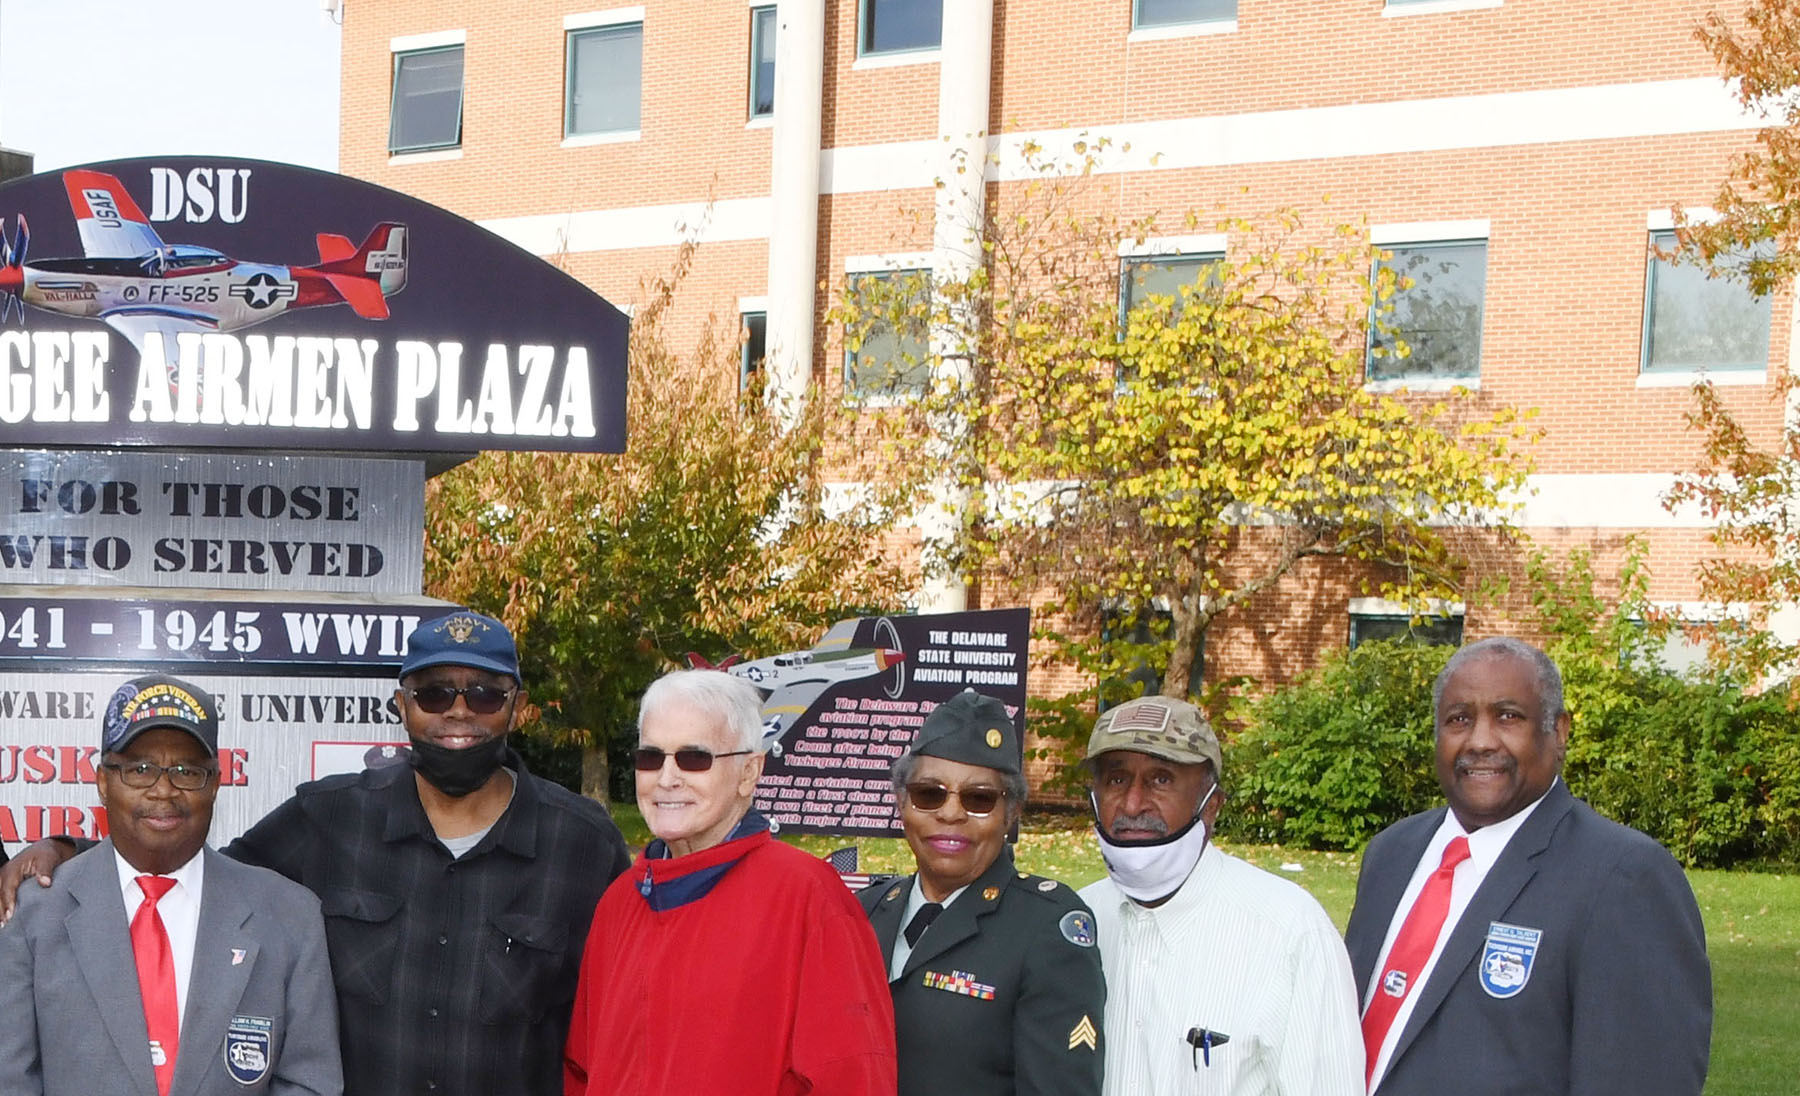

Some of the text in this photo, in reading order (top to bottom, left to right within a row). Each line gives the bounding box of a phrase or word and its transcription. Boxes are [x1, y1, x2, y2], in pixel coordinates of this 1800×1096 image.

[150, 168, 251, 223] DSU
[96, 191, 122, 228] USAF
[148, 285, 219, 302] FF-525
[131, 331, 378, 432] AIRMEN
[394, 341, 596, 438] PLAZA
[21, 478, 361, 522] FOR THOSE
[154, 537, 385, 578] SERVED
[137, 607, 261, 653] 1945
[283, 613, 420, 656] WWII
[929, 630, 1008, 647] THE DELAWARE
[918, 650, 1016, 666] STATE UNIVERSITY
[773, 670, 779, 678] 2
[913, 668, 1018, 685] AVIATION PROGRAM
[135, 684, 168, 703] FORCE
[168, 684, 208, 720] VETERAN
[835, 698, 857, 710] The
[859, 699, 918, 712] Delaware
[819, 712, 925, 727] aviation program
[806, 726, 828, 738] the
[870, 728, 888, 742] by
[889, 729, 911, 741] the
[833, 742, 867, 755] after
[867, 743, 902, 757] being
[784, 754, 890, 770] Tuskegee Airmen.
[794, 776, 811, 787] an
[813, 777, 863, 789] aviation
[779, 788, 805, 799] into
[817, 789, 847, 801] first
[847, 791, 881, 802] class
[773, 802, 800, 812] own
[801, 801, 833, 813] fleet
[834, 803, 850, 814] of
[850, 804, 894, 816] planes
[803, 815, 841, 828] major
[841, 816, 889, 828] airlines
